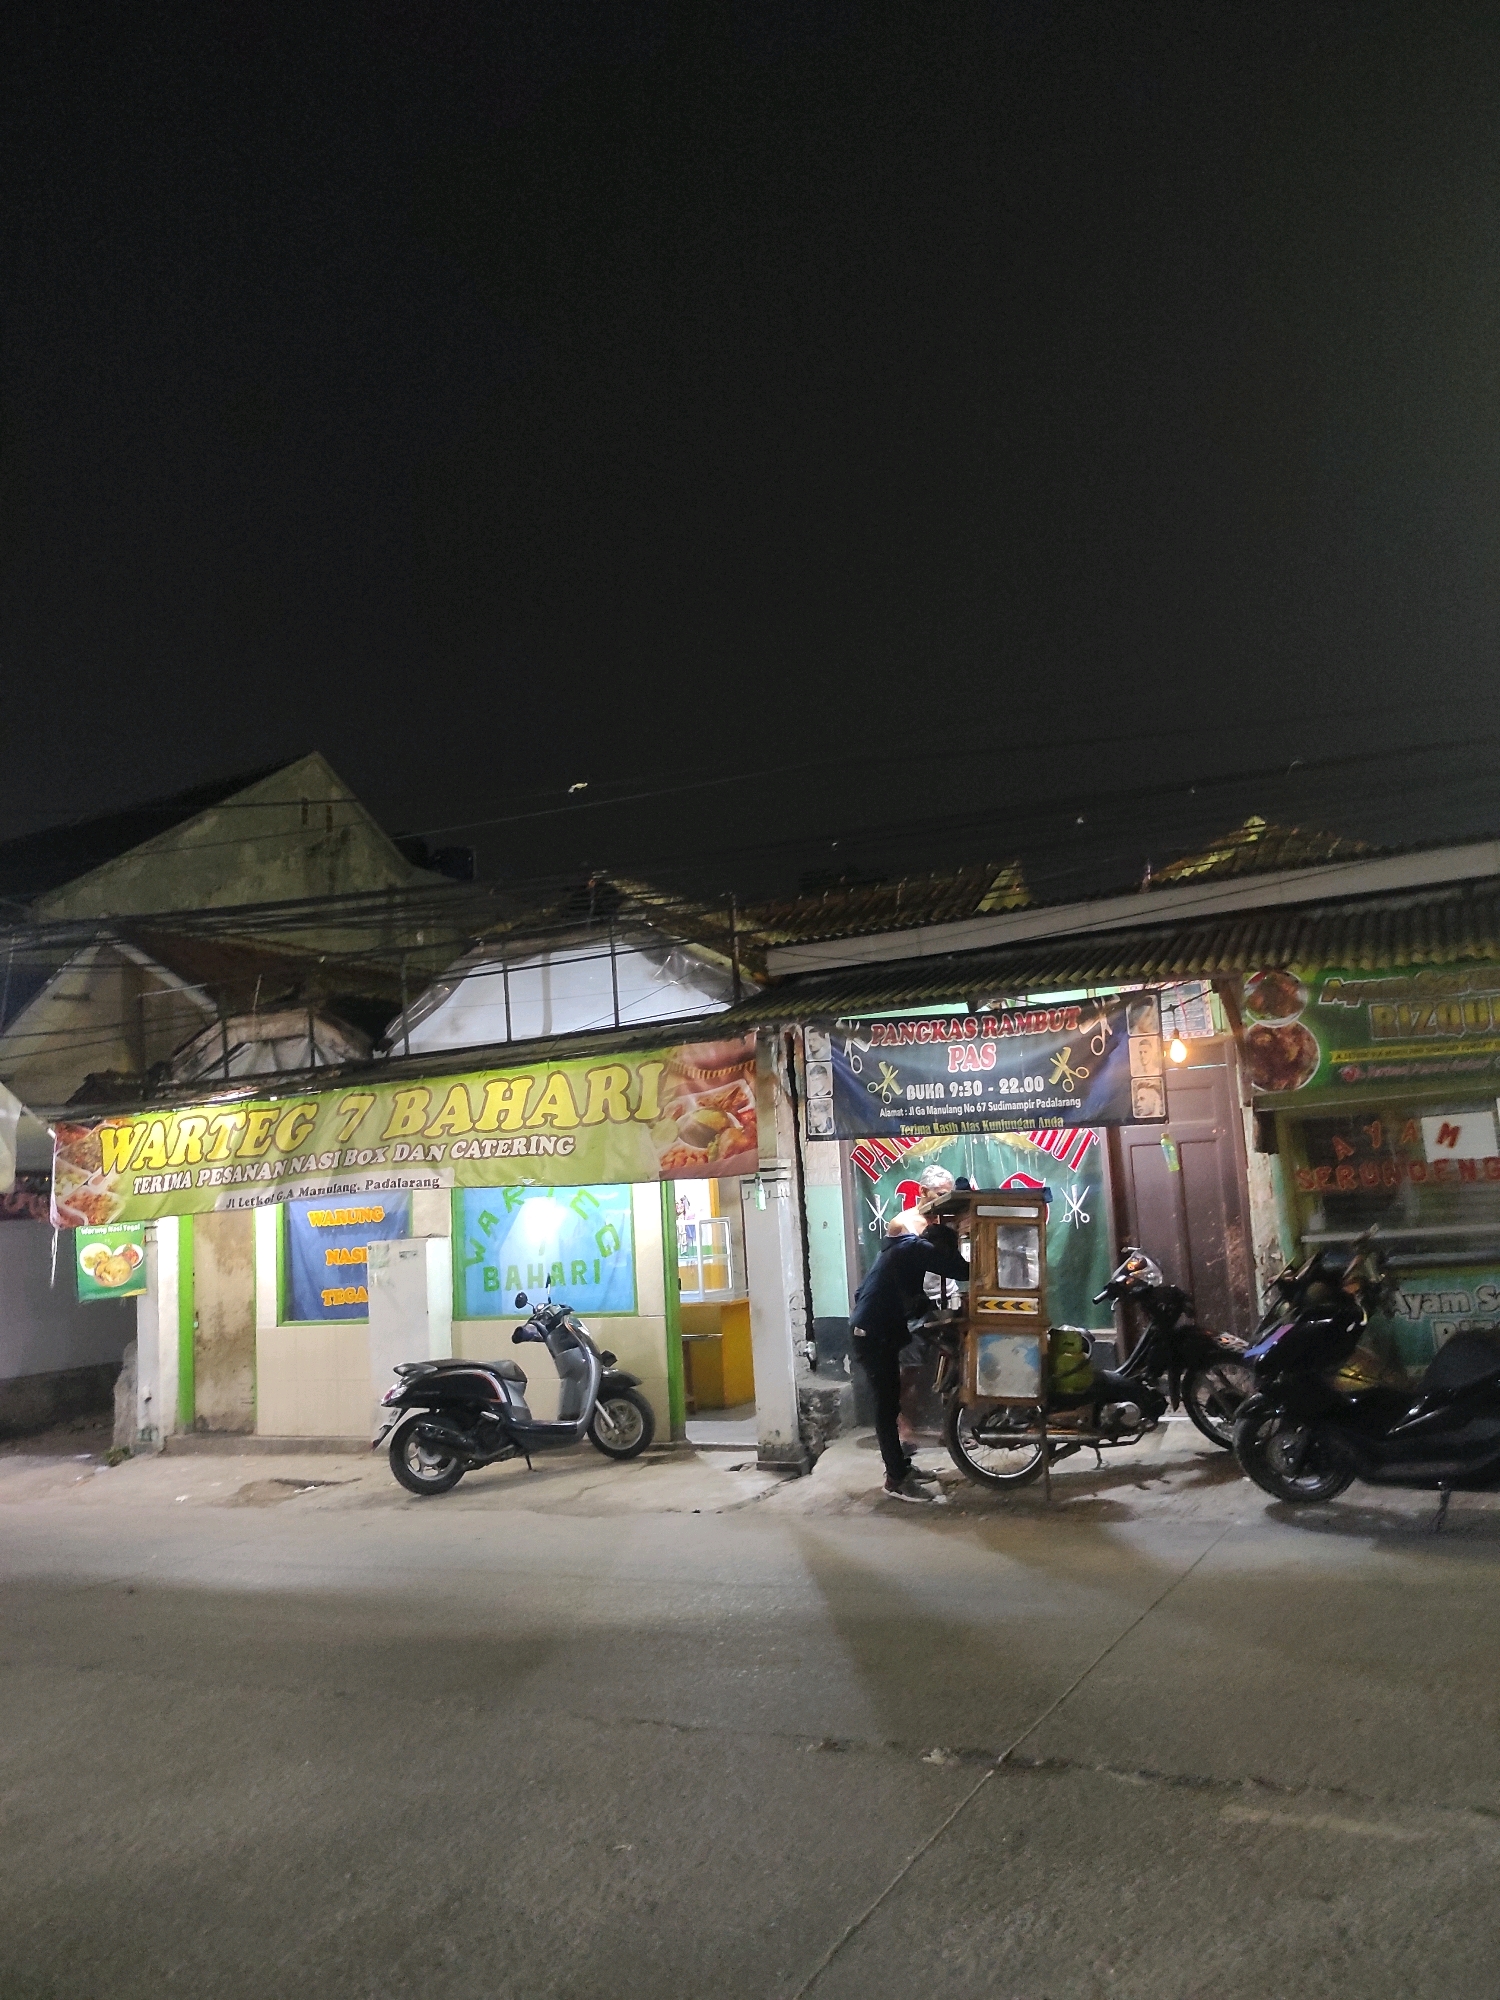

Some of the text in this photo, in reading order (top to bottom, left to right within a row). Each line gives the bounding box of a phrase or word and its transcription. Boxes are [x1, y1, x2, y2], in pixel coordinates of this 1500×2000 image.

[870, 1006, 1081, 1047] PANGKAS RAMBUT
[948, 1042, 997, 1072] PAS
[906, 1082, 945, 1100] BUKA
[949, 1079, 983, 1098] 9:30
[999, 1076, 1045, 1094] 22.00
[100, 1060, 667, 1177] WARTEG 7 BAHARI
[880, 1108, 904, 1118] Alamat
[926, 1103, 963, 1116] Manulang
[964, 1103, 975, 1113] No
[976, 1102, 986, 1112] 67
[987, 1099, 1035, 1111] Sudimampir
[1036, 1097, 1081, 1108] Padalarang
[900, 1116, 1064, 1136] Terima Kasih Atas Kunjungan Anda
[133, 1133, 576, 1196] TERIMA PESANAN NASI BOX DAN CATERING
[365, 1177, 440, 1190] Padalarang
[307, 1206, 385, 1228] WARUNG
[325, 1246, 368, 1266] NASI
[482, 1259, 601, 1292] BAHARI
[321, 1286, 368, 1307] TEGA
[1475, 1283, 1500, 1313] S
